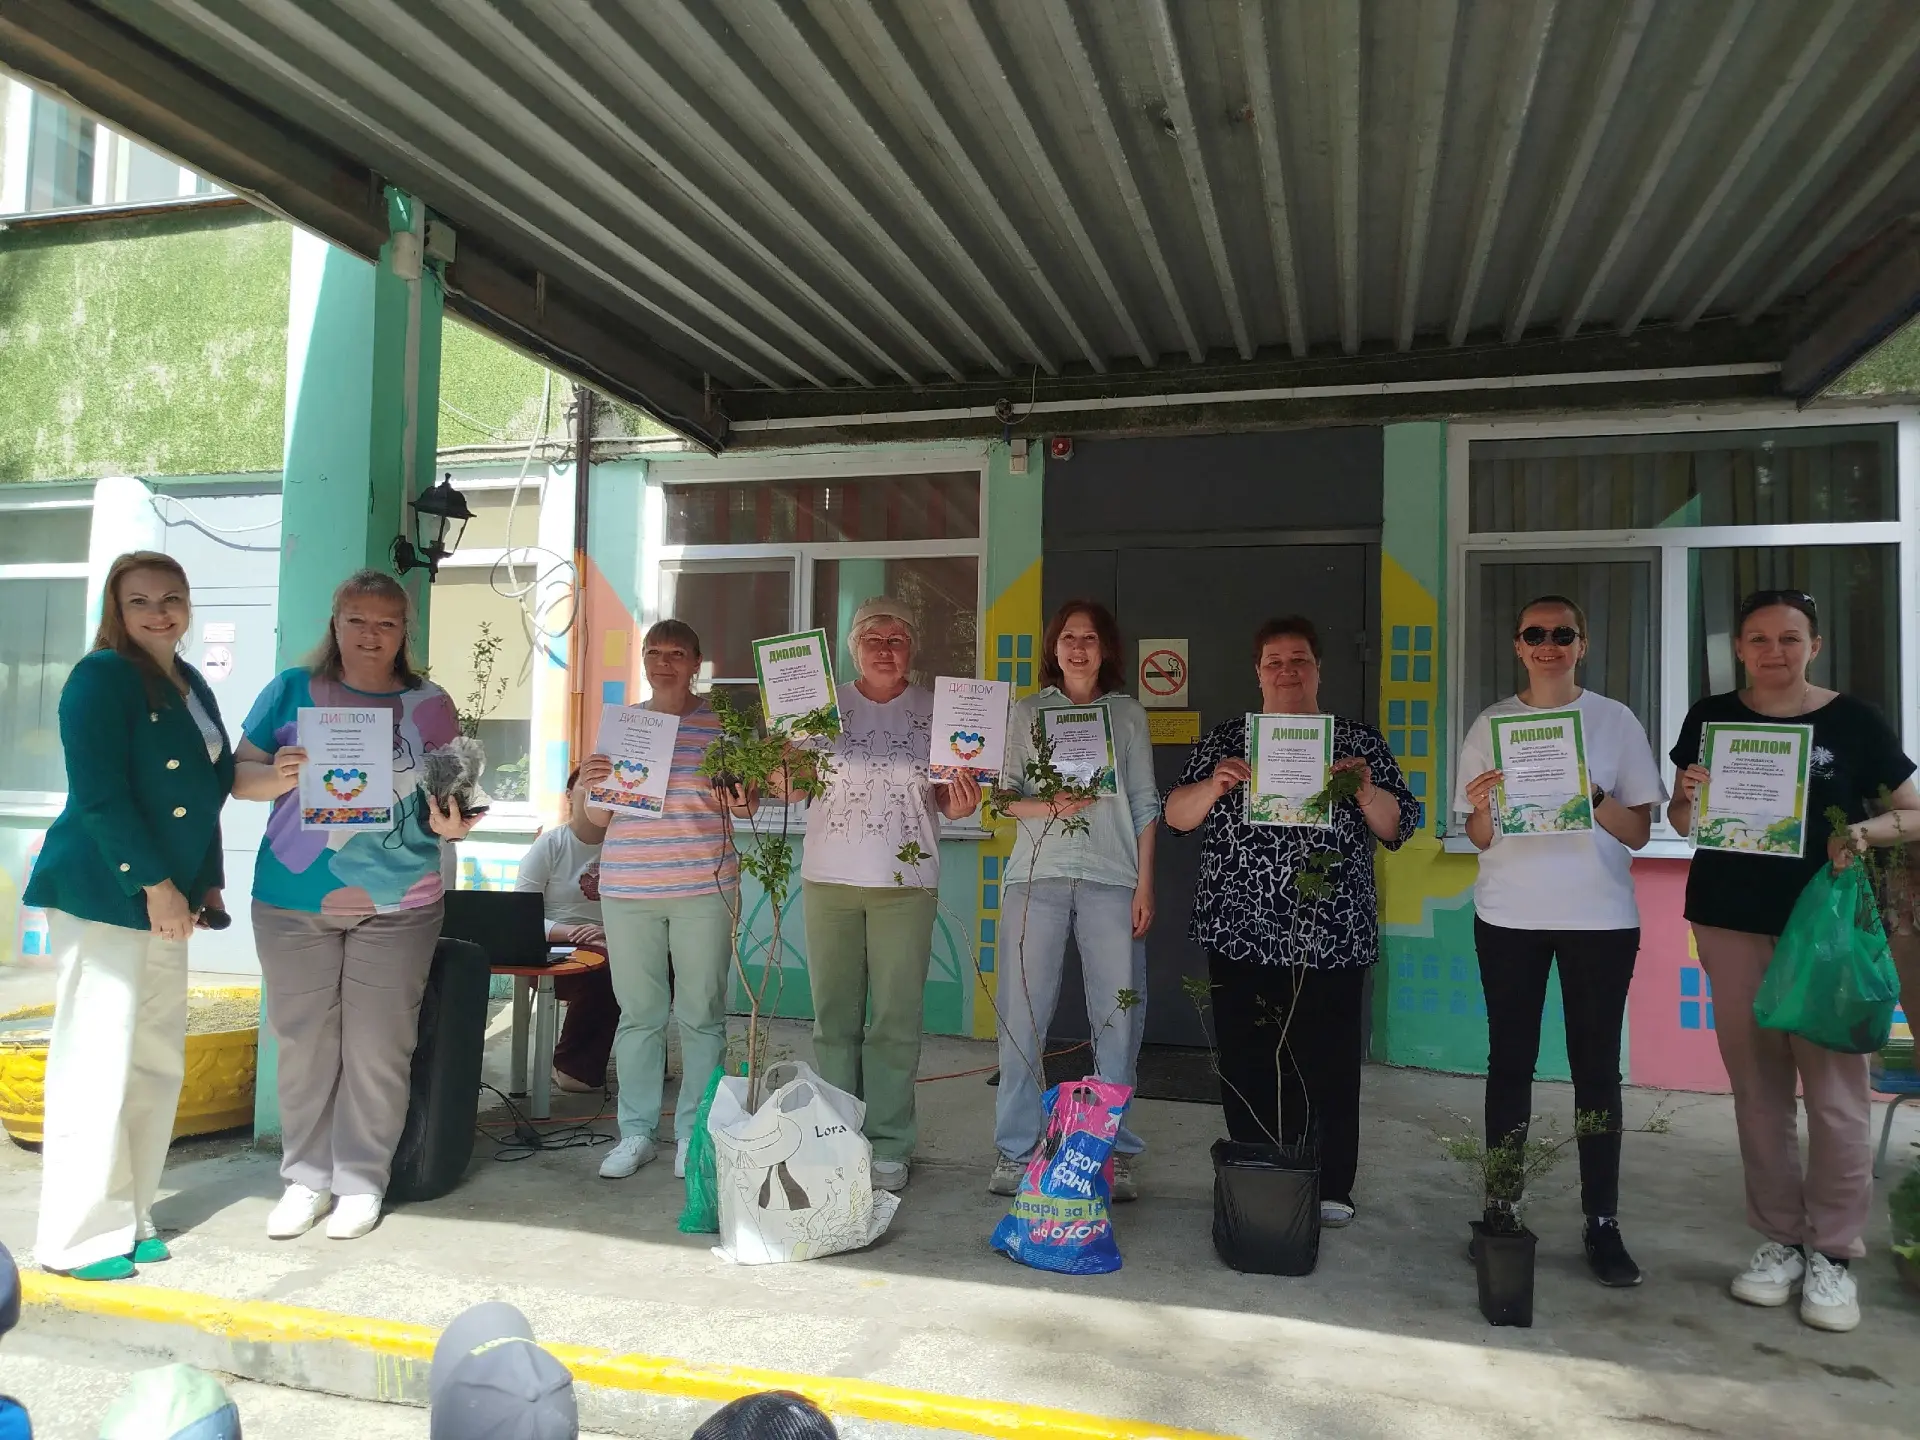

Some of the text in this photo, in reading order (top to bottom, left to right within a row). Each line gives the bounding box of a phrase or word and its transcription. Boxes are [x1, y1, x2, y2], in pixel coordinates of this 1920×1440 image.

[768, 644, 812, 664] ДИПЛОМ
[948, 682, 993, 694] ДИПЛОМ
[318, 712, 376, 725] ДИПЛОМ
[618, 712, 664, 728] ДИПЛОМ
[1056, 712, 1098, 725] ДИПЛОМ
[1272, 727, 1319, 741] ДИПЛОМ
[1510, 725, 1564, 744] ДИПЛОМ
[1729, 738, 1792, 754] ДИПЛОМ
[814, 1124, 848, 1138] Lora
[1065, 1148, 1102, 1175] ozon
[1054, 1162, 1094, 1196] банк
[1013, 1200, 1059, 1217] овары
[1065, 1208, 1083, 1217] за
[1033, 1223, 1106, 1239] на OZON
